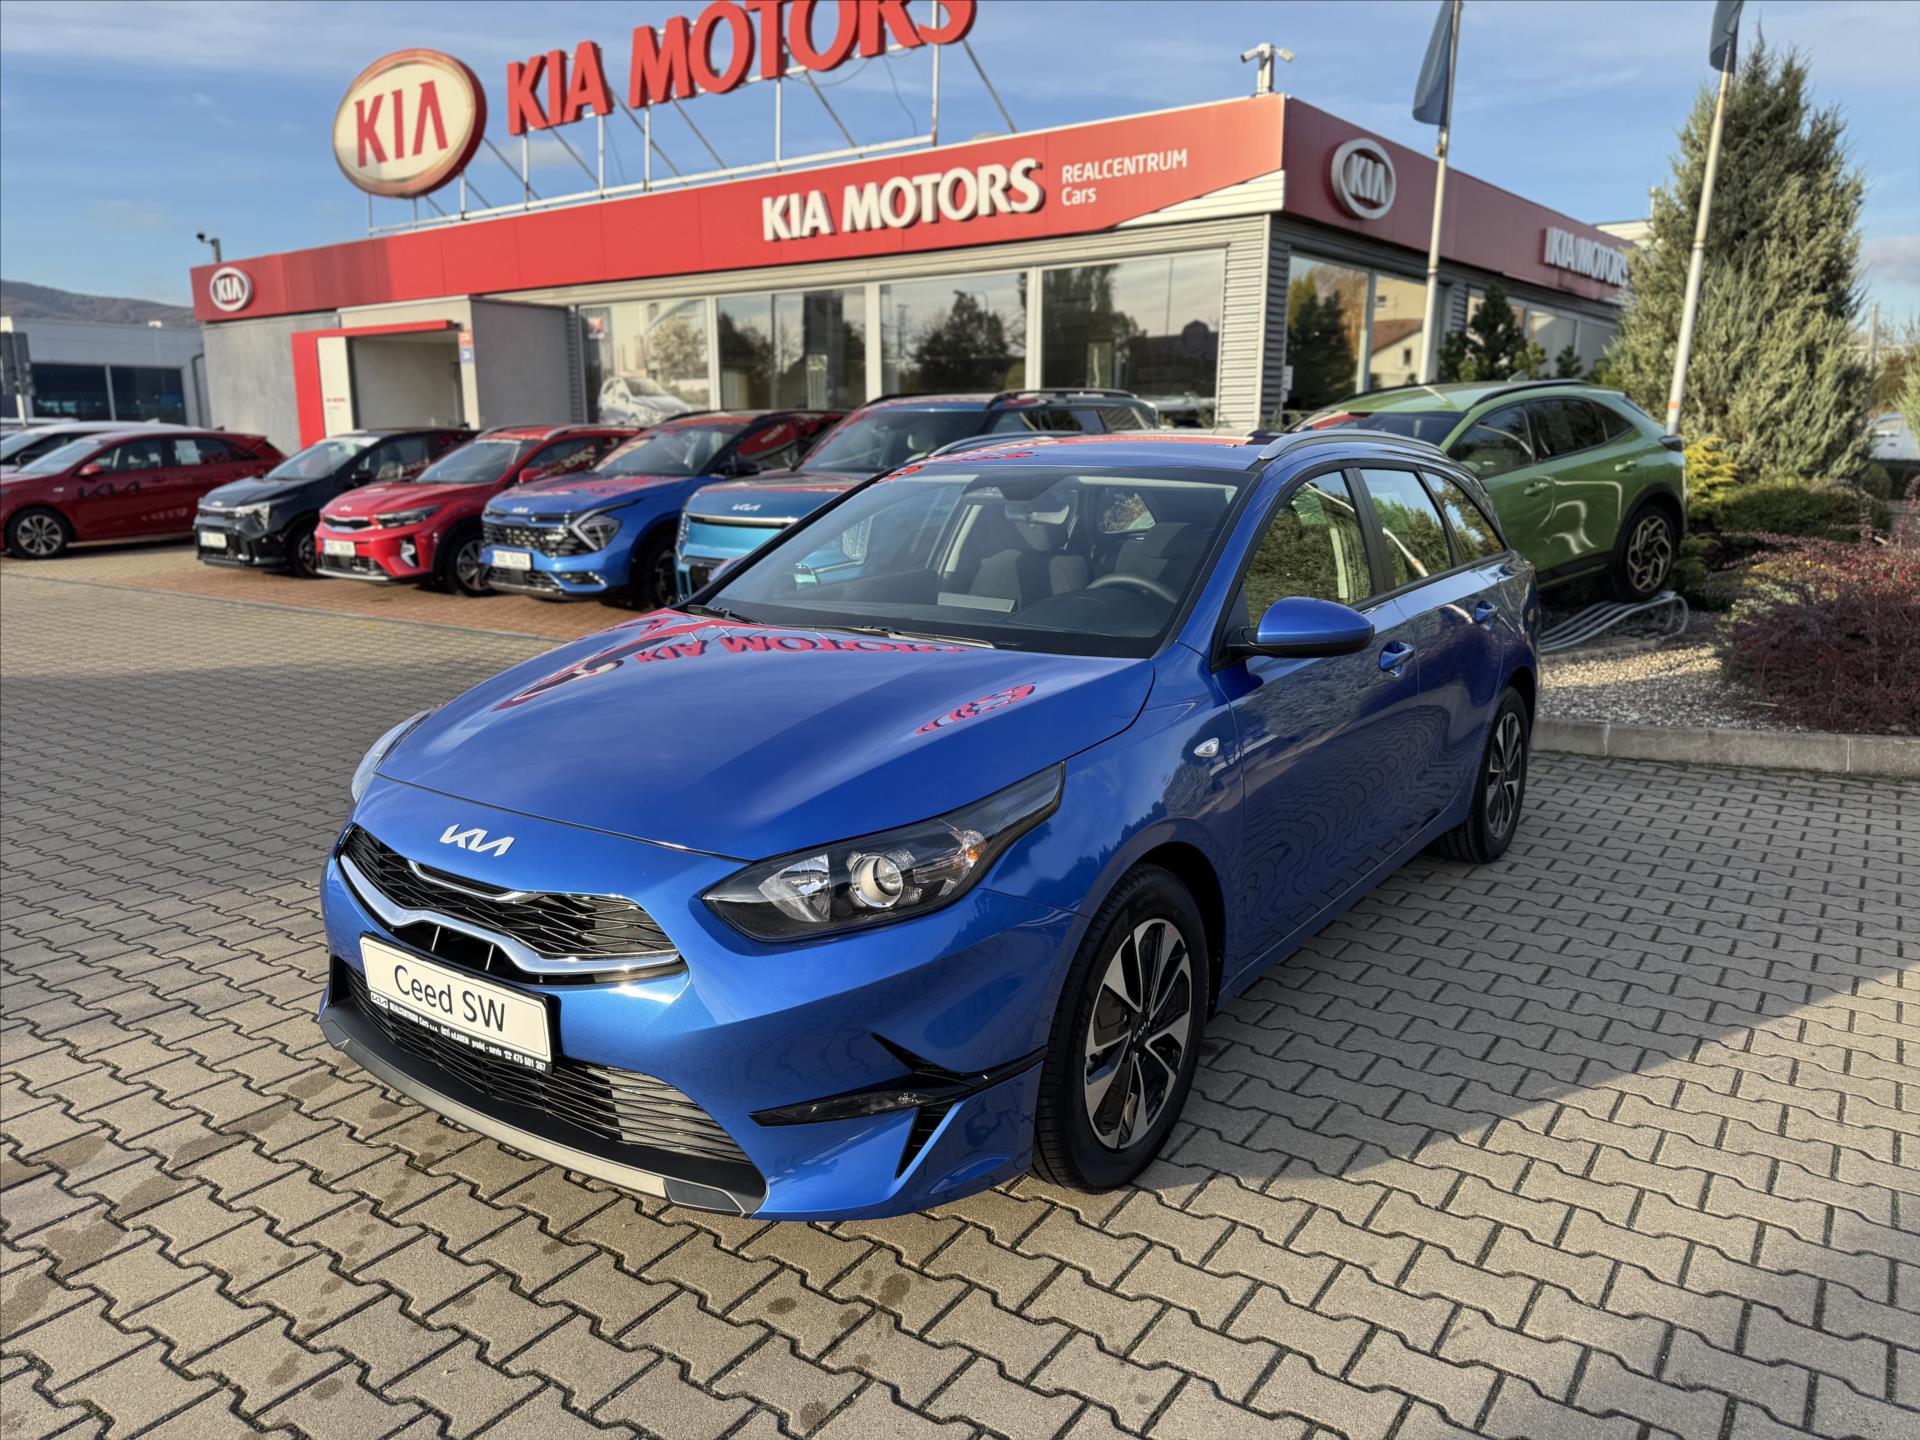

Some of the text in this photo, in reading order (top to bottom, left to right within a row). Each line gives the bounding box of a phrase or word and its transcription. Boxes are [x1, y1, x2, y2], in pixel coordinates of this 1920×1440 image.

[507, 40, 612, 135] KIA
[354, 81, 449, 168] KIA
[1061, 148, 1188, 184] REALCENTRUM
[1350, 153, 1386, 206] KIA
[762, 157, 1042, 241] KIA MOTORS
[1061, 186, 1097, 207] Cars
[1544, 227, 1574, 272] KIA
[216, 276, 243, 302] KIA
[439, 823, 515, 857] KIA
[394, 964, 454, 1015] Ceed
[462, 990, 506, 1032] SW
